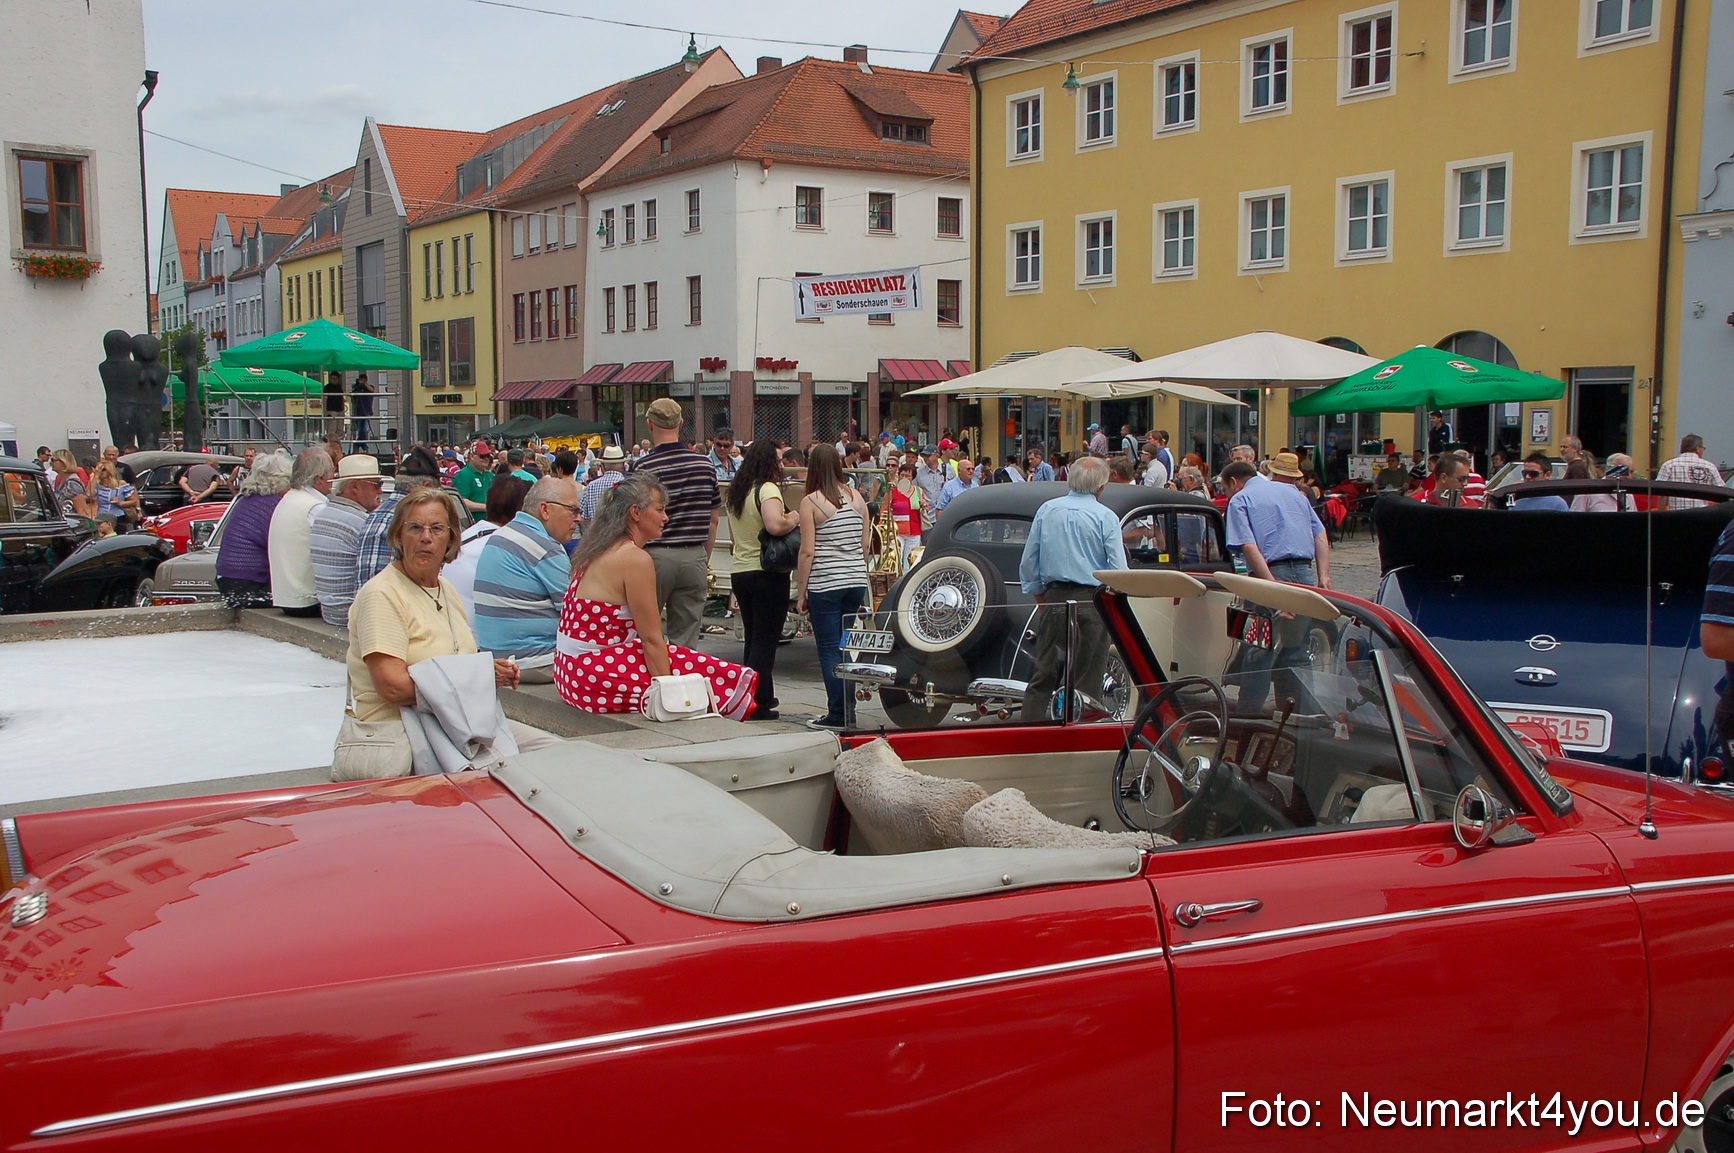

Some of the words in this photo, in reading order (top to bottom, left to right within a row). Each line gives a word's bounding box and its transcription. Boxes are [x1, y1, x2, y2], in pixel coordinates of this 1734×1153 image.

[811, 275, 906, 296] RESIDENZPLATZ
[836, 298, 889, 310] Sonderschauen
[756, 357, 799, 373] Döpfer
[847, 632, 865, 647] NM
